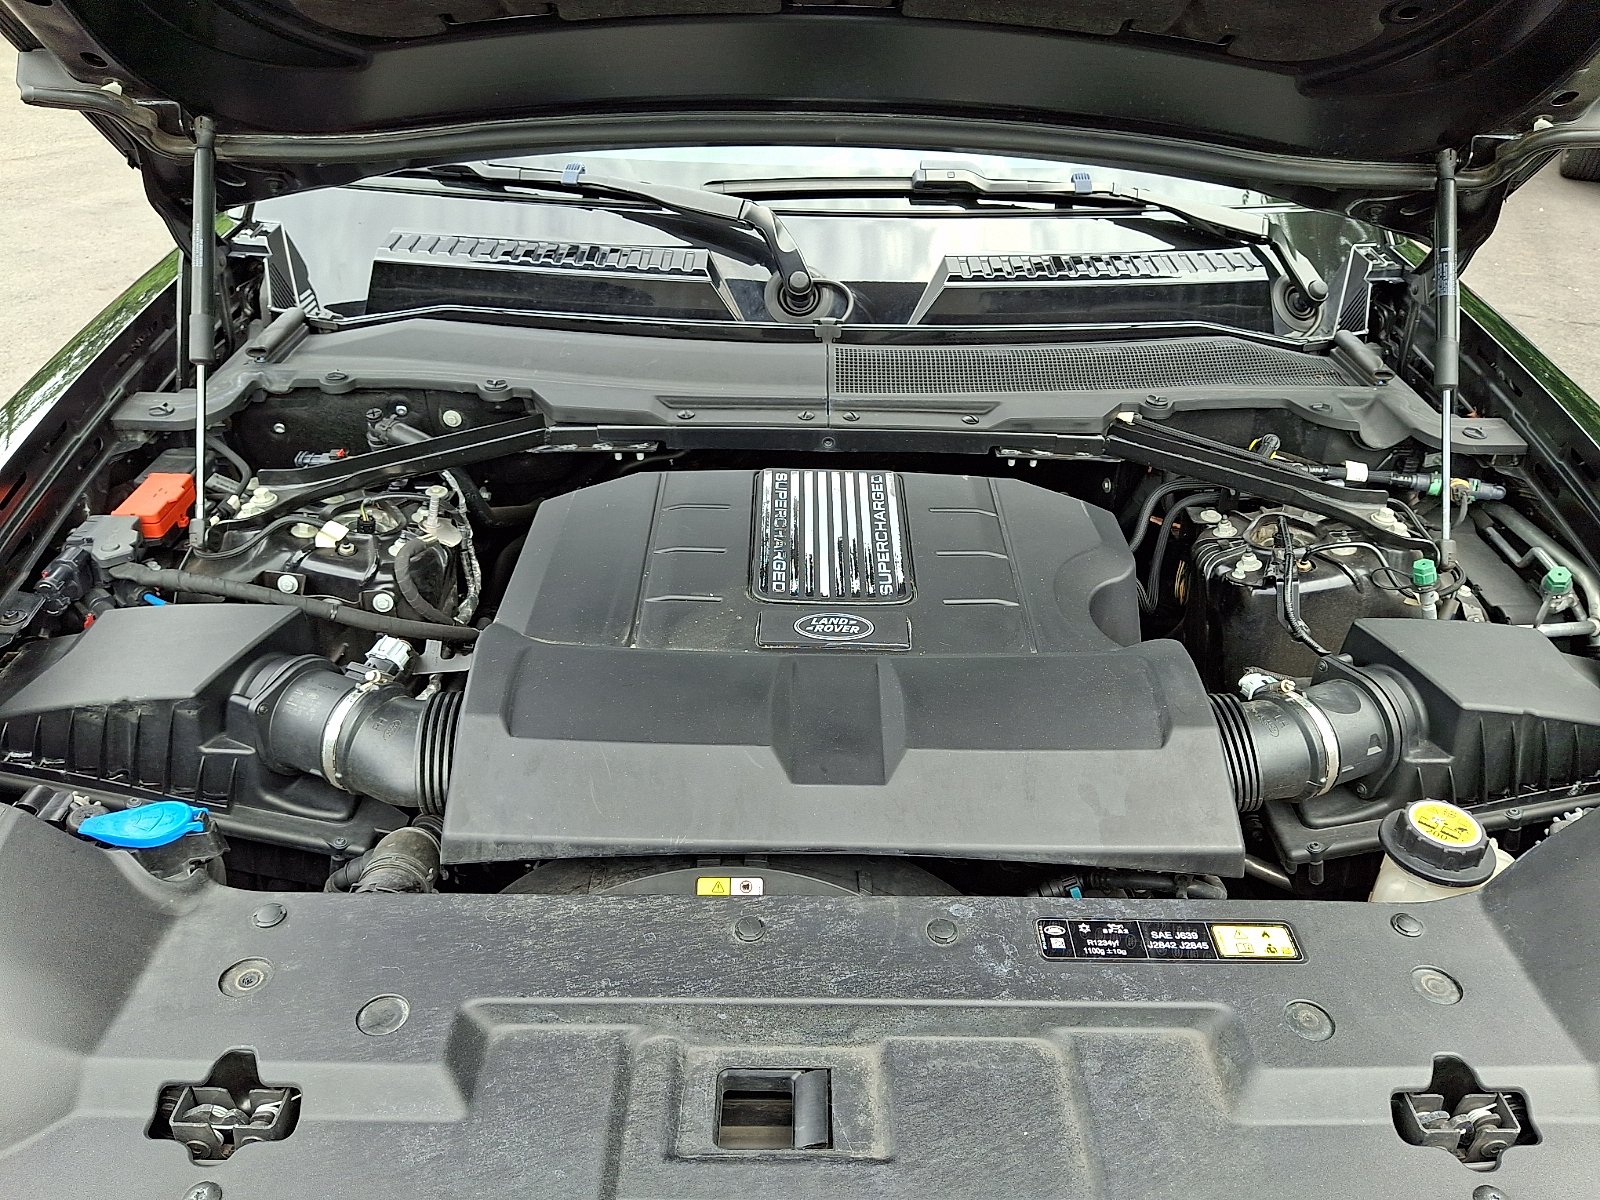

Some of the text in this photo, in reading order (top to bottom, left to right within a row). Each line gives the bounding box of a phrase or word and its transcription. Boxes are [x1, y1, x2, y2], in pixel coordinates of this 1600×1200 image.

[772, 472, 788, 593] SUPERCHARGED
[870, 474, 894, 596] SUPERCHARGED
[810, 617, 849, 625] LAND
[813, 625, 861, 634] ROVER
[1150, 931, 1199, 940] SAE J639
[1086, 939, 1120, 948] R1234yf
[1147, 941, 1209, 950] J2842 J2845
[1083, 947, 1128, 956] 1100g ±10g
